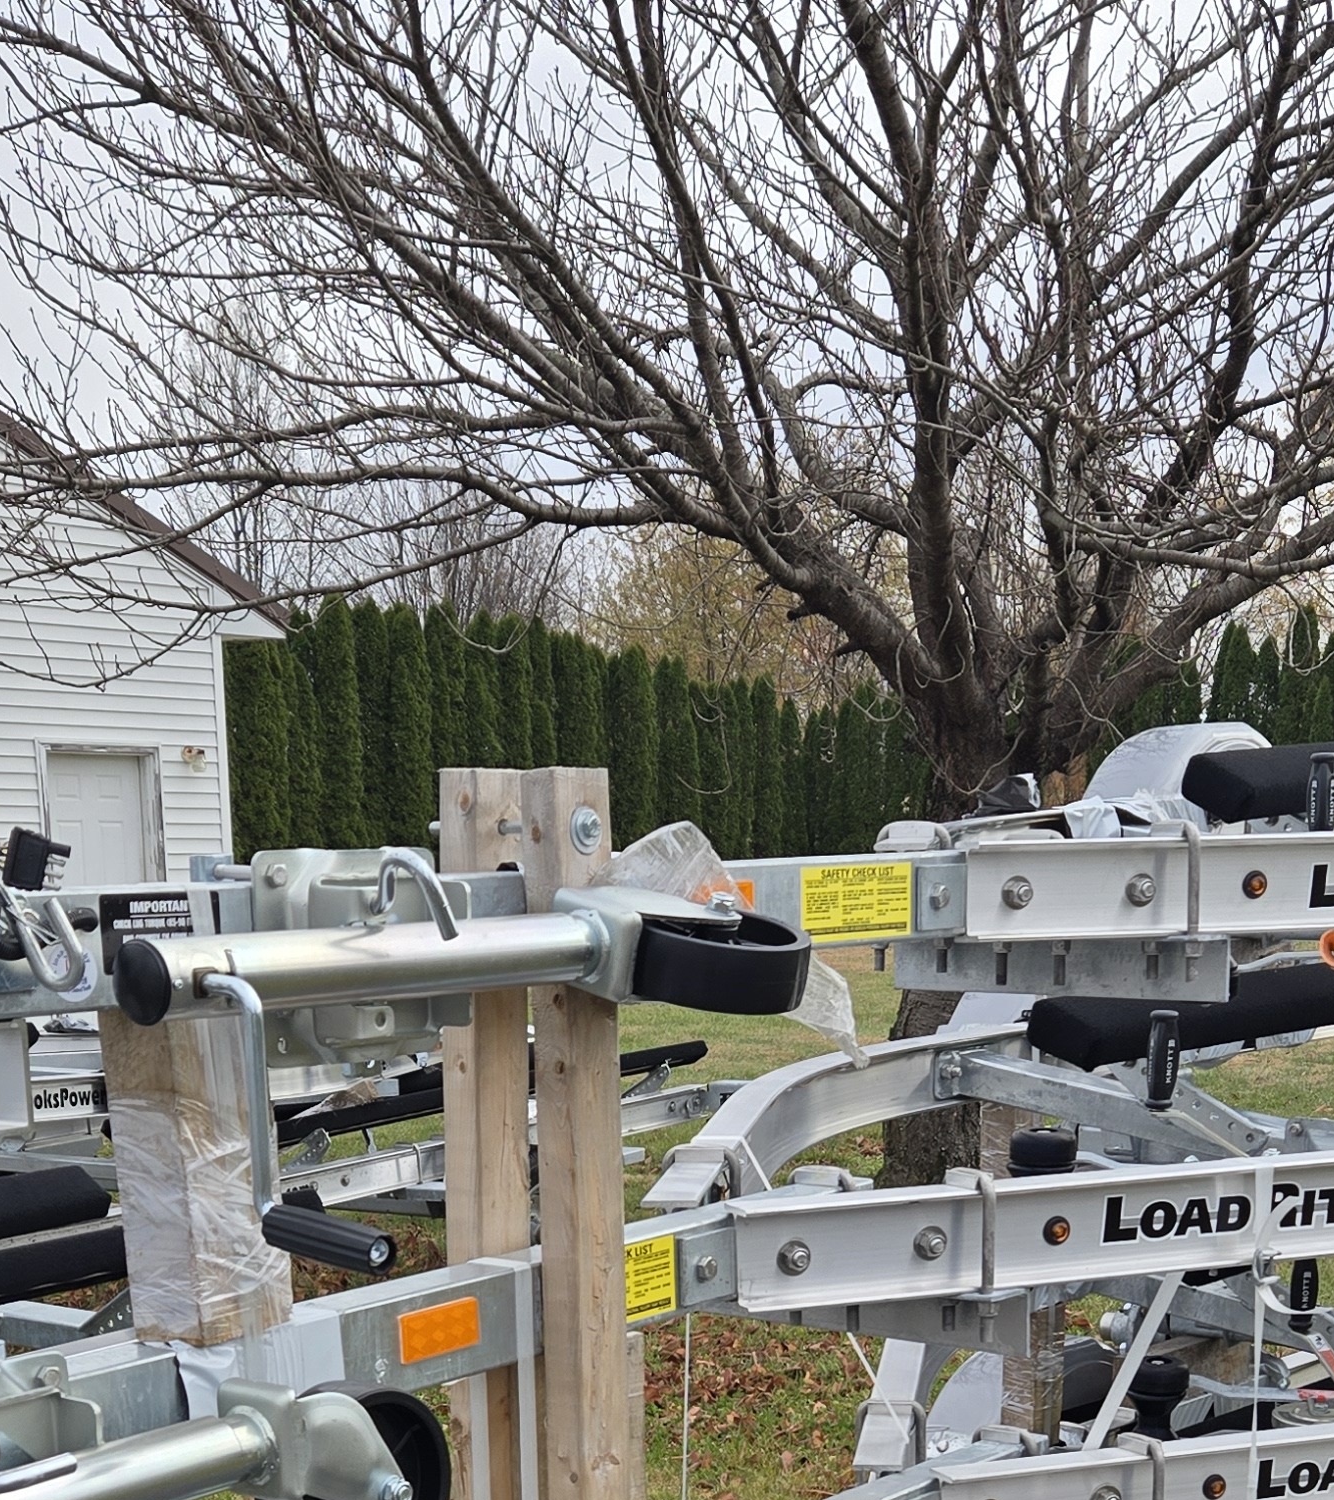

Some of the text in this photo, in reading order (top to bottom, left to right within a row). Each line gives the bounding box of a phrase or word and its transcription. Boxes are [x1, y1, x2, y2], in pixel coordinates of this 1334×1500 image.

[821, 866, 895, 880] SAFETY CHECK LIST
[129, 900, 189, 914] IMPORTAN
[635, 1243, 653, 1257] LIST
